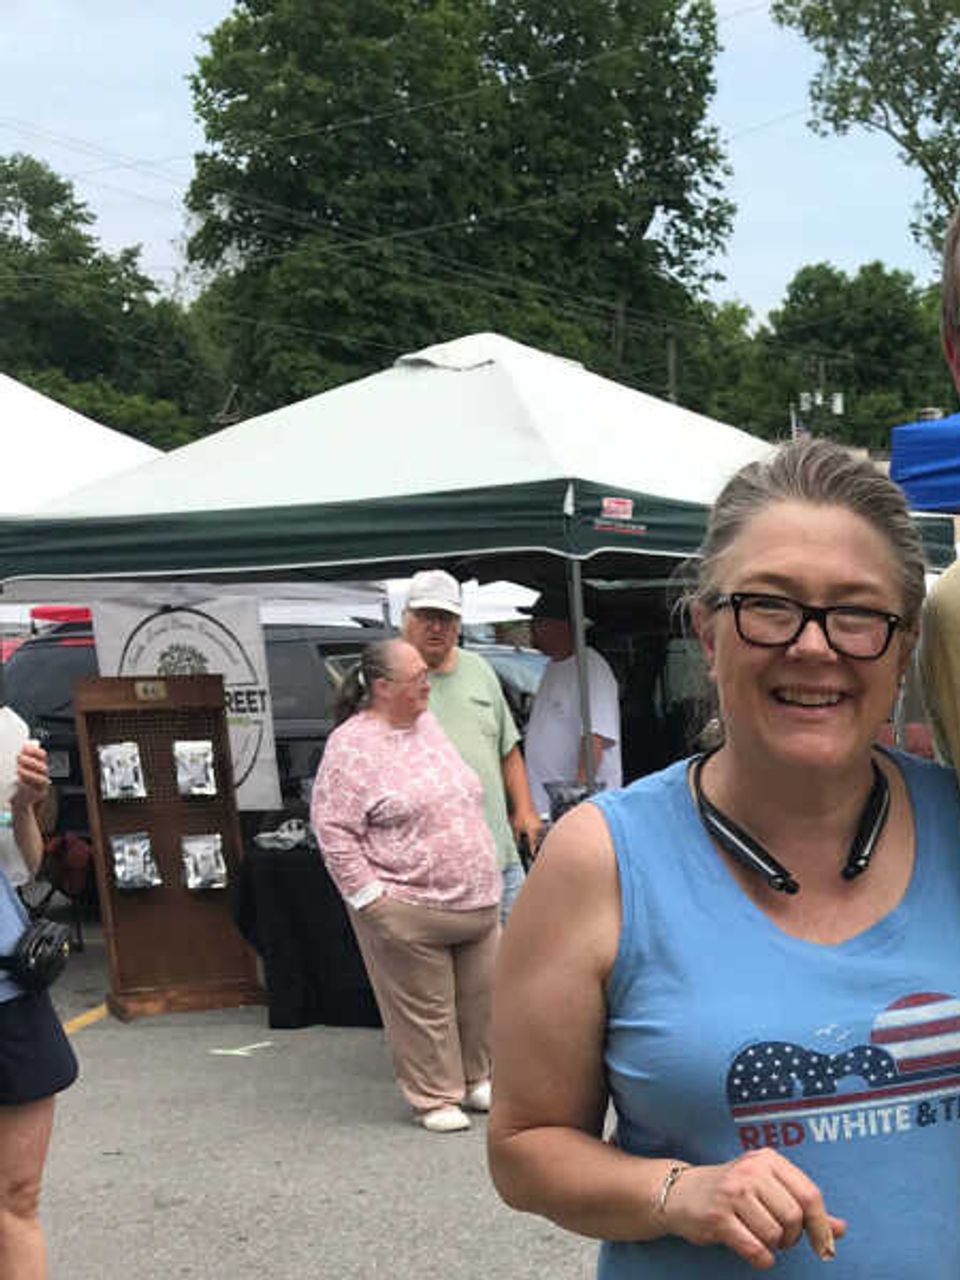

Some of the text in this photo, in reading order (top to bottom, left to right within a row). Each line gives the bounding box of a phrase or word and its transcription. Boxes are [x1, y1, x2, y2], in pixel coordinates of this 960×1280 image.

[738, 1120, 805, 1150] RED
[808, 1105, 912, 1143] WHITE
[916, 1101, 937, 1128] &
